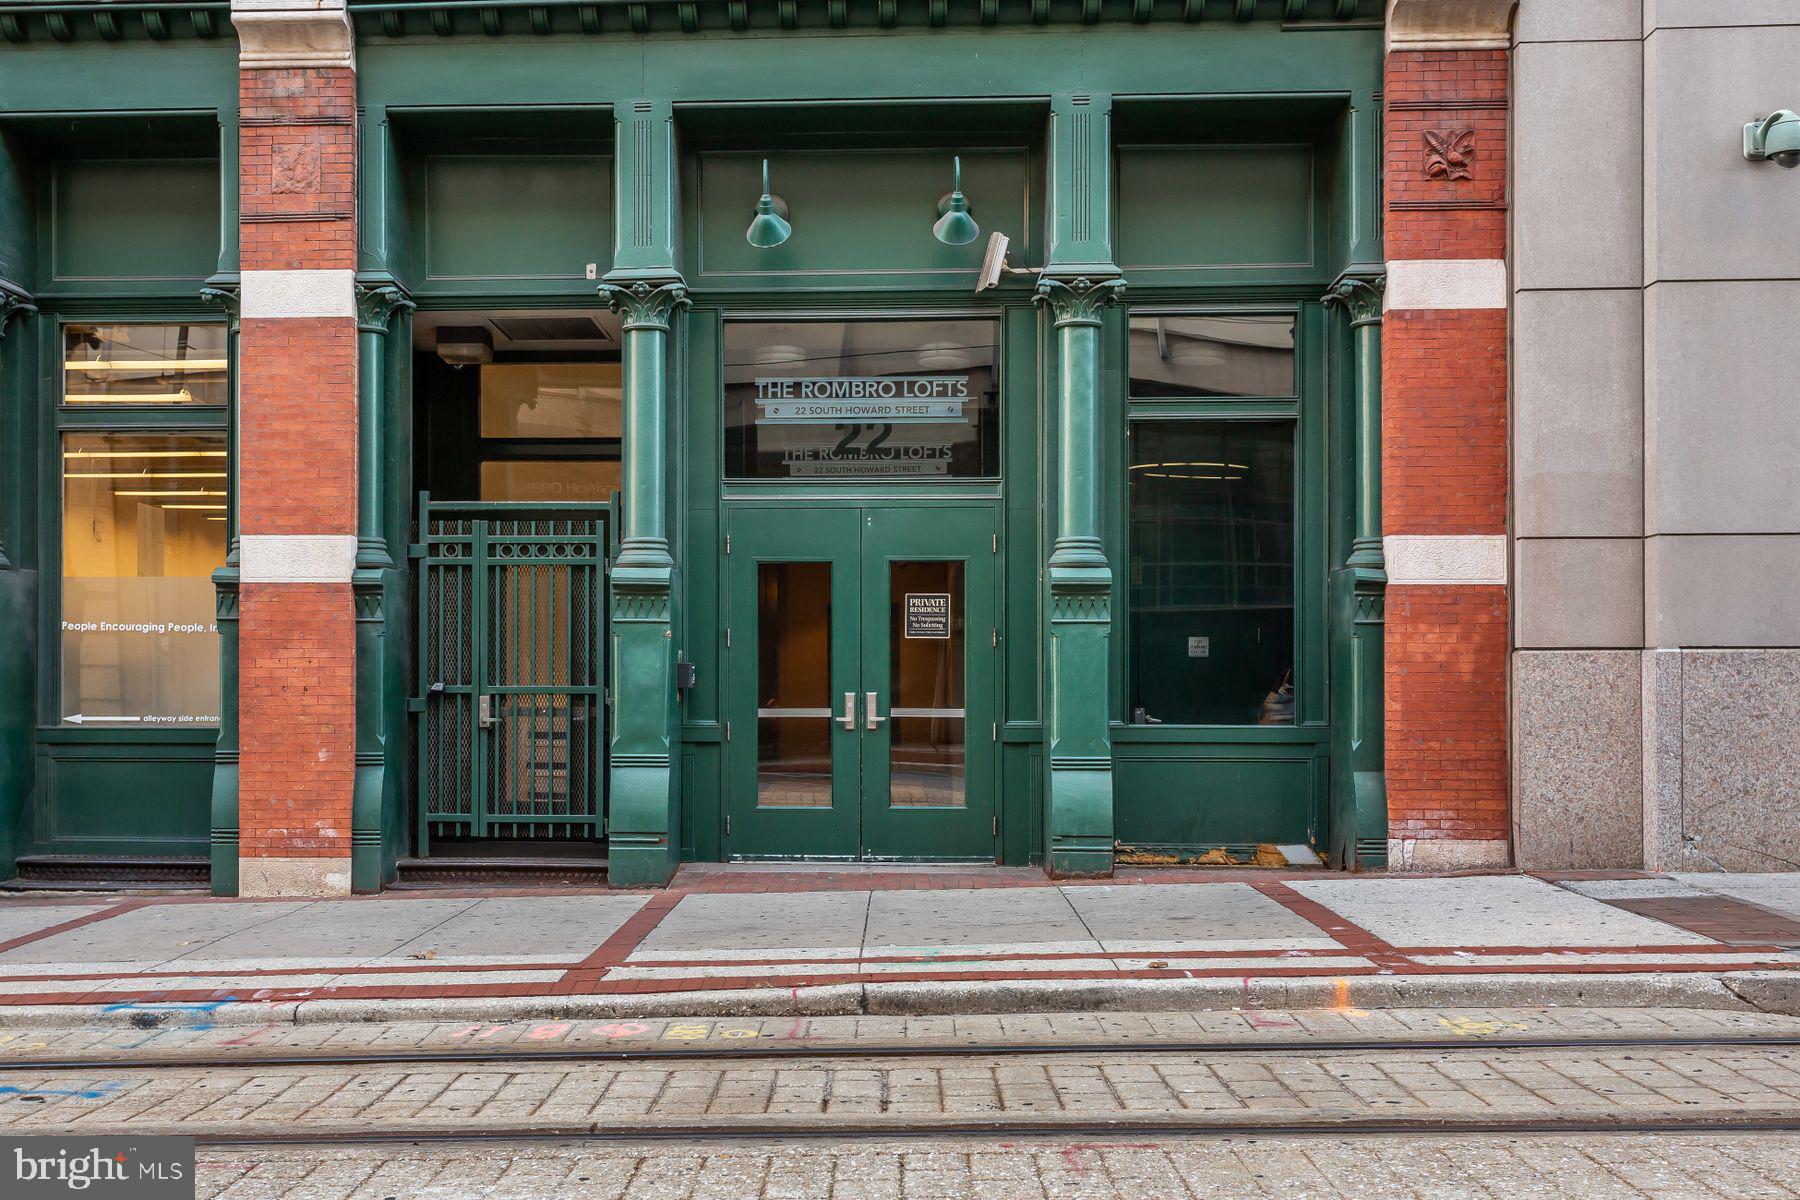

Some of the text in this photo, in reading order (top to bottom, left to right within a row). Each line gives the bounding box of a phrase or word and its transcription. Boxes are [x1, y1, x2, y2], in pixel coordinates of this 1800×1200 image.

[755, 380, 968, 398] THE ROMBRO LOFTS
[795, 405, 930, 415] 22 SOUTH HOWARD STREET
[835, 423, 893, 453] 22
[783, 447, 814, 461] THE
[900, 445, 953, 459] LOFTS
[854, 466, 891, 474] HOWARD
[893, 465, 922, 473] STREET
[909, 598, 946, 607] PRIVATE
[61, 621, 97, 632] People
[100, 621, 165, 634] Encouraging
[168, 622, 207, 634] People,
[143, 715, 177, 723] alleyway
